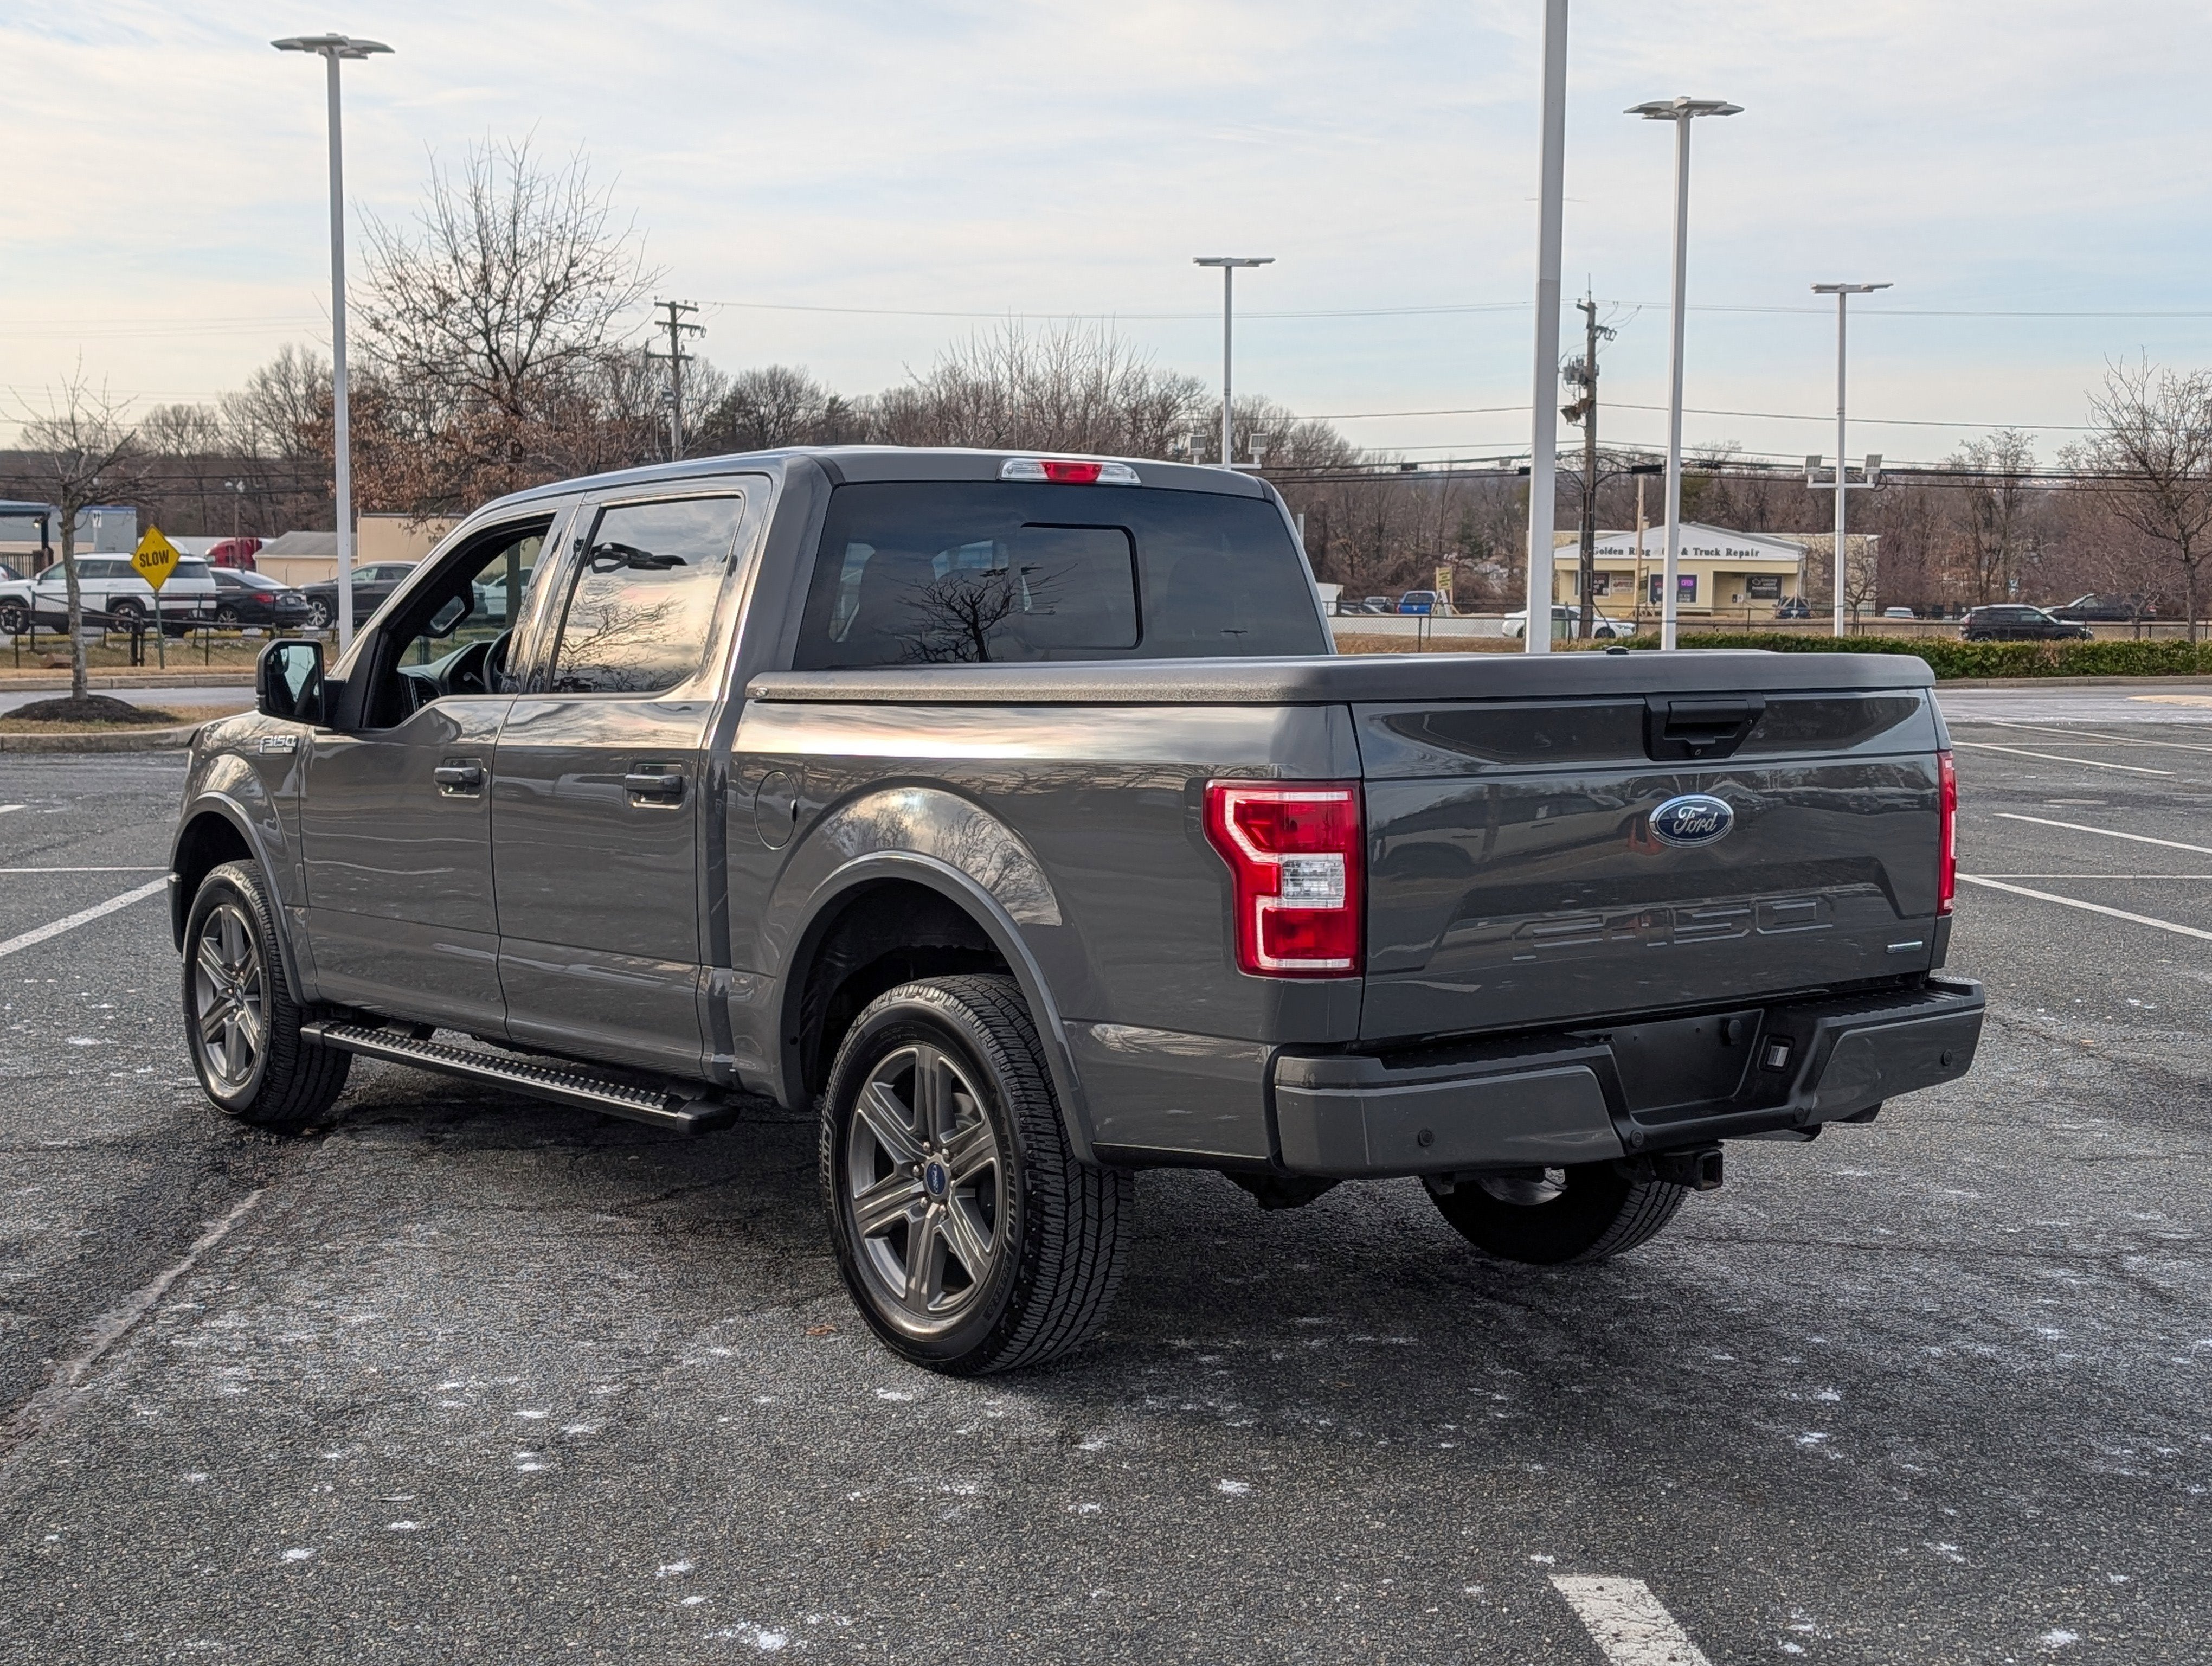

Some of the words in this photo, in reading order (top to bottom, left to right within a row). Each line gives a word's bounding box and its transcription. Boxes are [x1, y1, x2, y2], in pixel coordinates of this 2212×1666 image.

[139, 550, 169, 568] SLOW
[1629, 547, 1651, 556] Rng
[1681, 547, 1688, 555] &
[1693, 548, 1720, 556] Truck
[1726, 548, 1760, 559] Repair
[1673, 806, 1718, 834] Ford
[1001, 1133, 1017, 1239] MICHELIN
